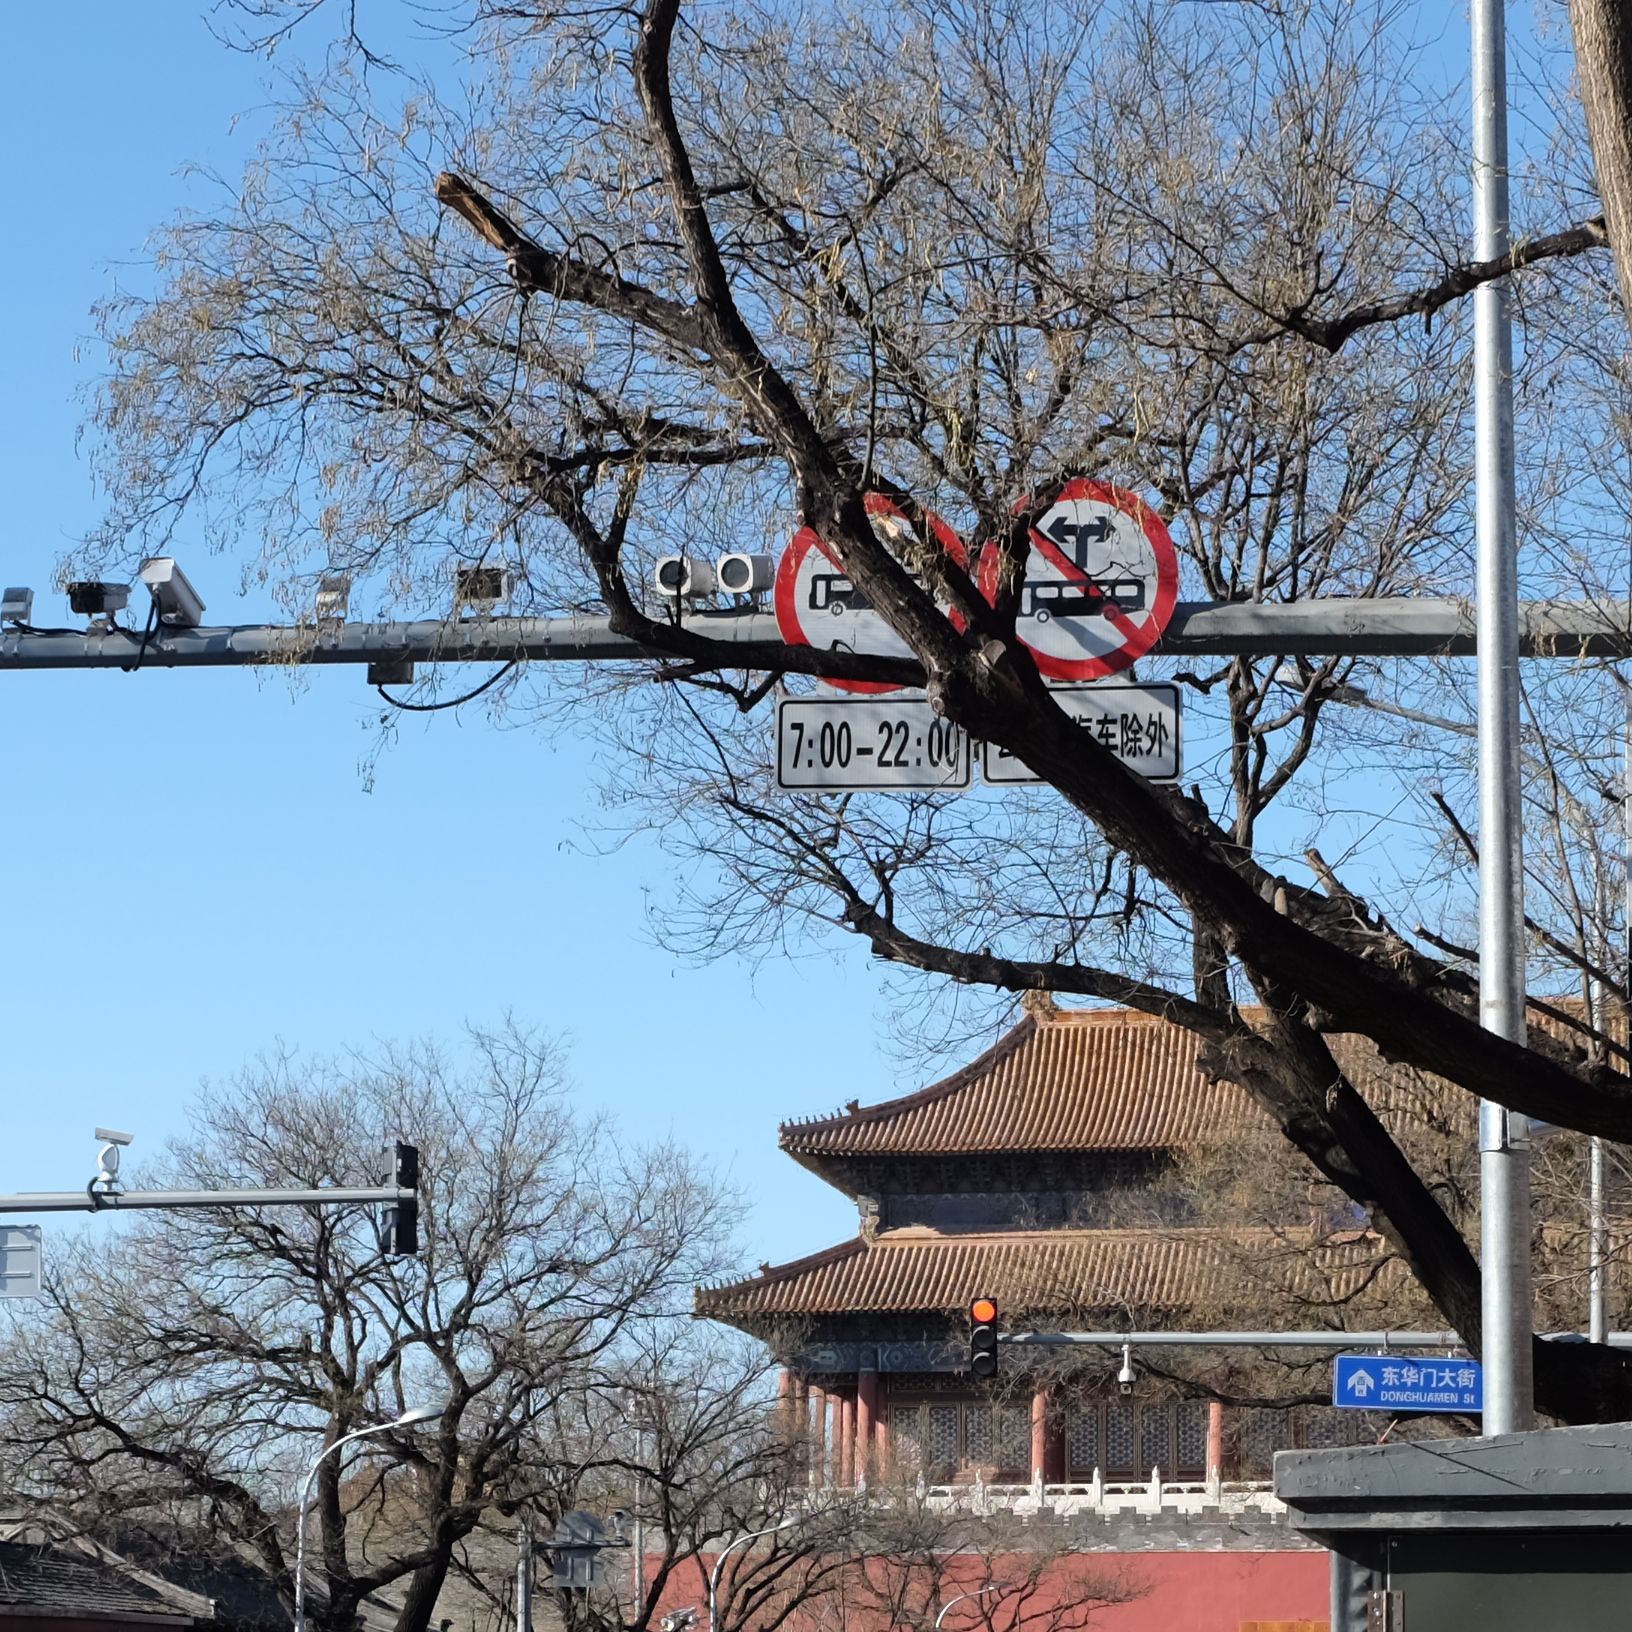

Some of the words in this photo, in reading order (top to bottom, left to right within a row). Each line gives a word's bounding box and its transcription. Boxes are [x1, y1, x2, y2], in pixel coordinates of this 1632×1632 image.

[1380, 1365, 1476, 1388] 东华门大街
[1380, 1391, 1459, 1404] DONGHUAMEN
[1463, 1393, 1475, 1405] St
